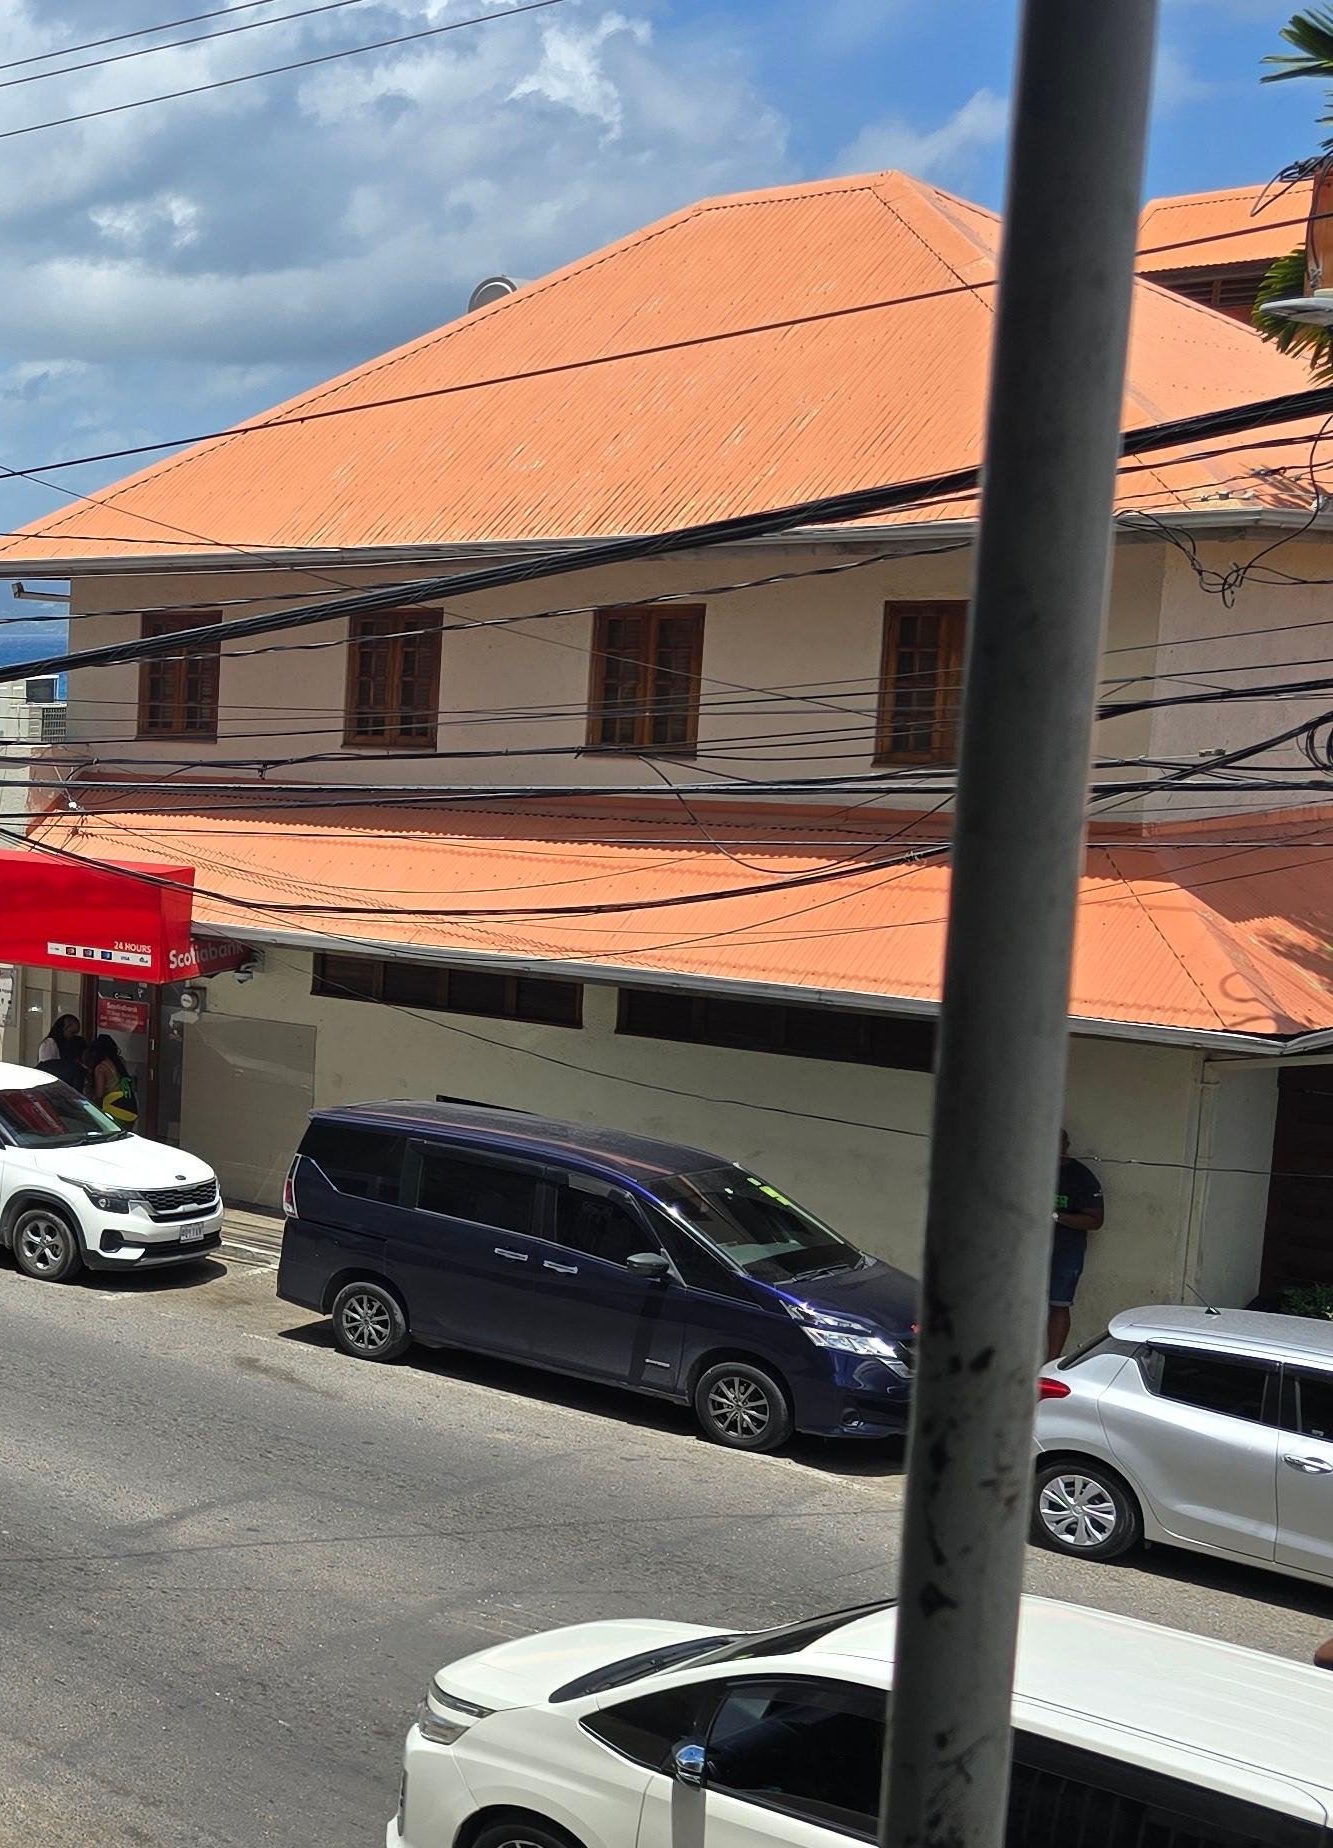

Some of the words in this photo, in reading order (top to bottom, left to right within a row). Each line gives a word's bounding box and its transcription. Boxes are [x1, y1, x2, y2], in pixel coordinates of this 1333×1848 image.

[113, 941, 124, 950] 24
[124, 942, 152, 954] HOURS
[169, 942, 244, 969] Scotiabank
